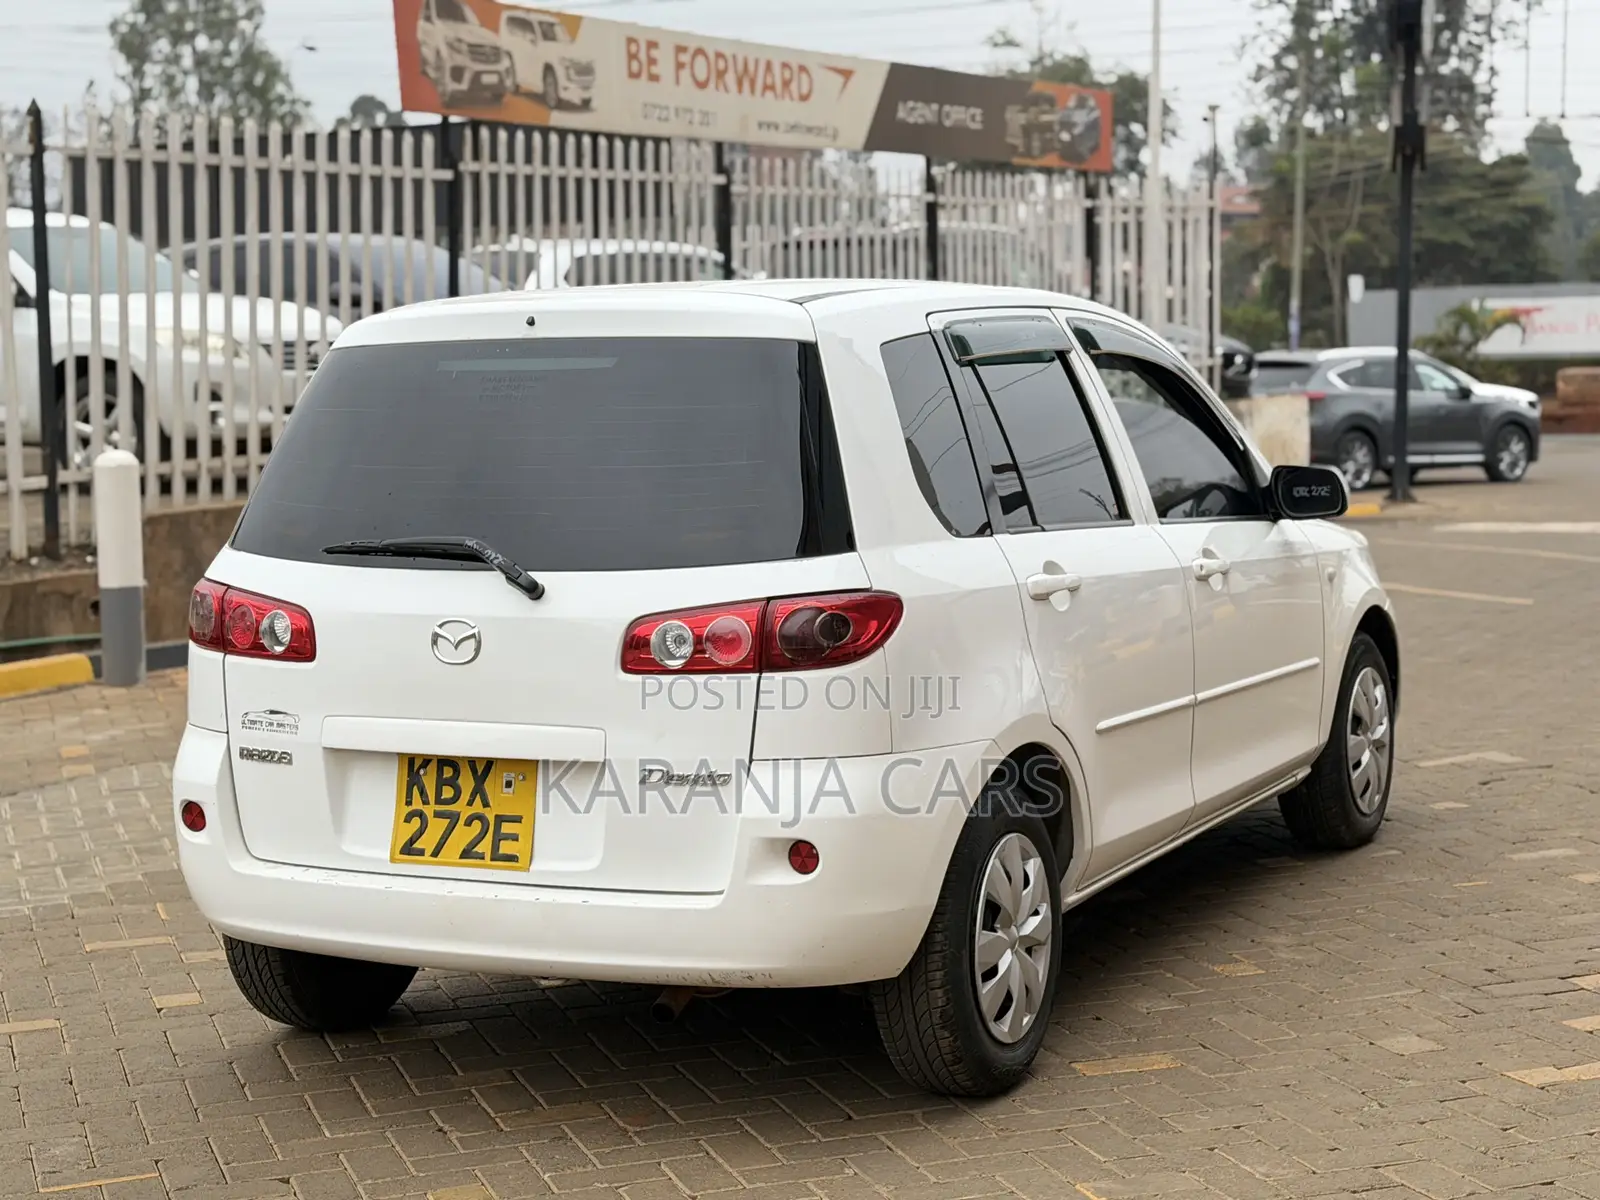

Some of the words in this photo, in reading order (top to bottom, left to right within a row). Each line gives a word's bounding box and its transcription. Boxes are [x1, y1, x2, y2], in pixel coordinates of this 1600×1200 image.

[625, 36, 661, 83] BE
[674, 44, 813, 103] FORWARD
[896, 100, 939, 124] AGENT
[941, 103, 984, 130] OFFICE
[404, 756, 494, 809] KBX
[399, 808, 524, 863] 272E
